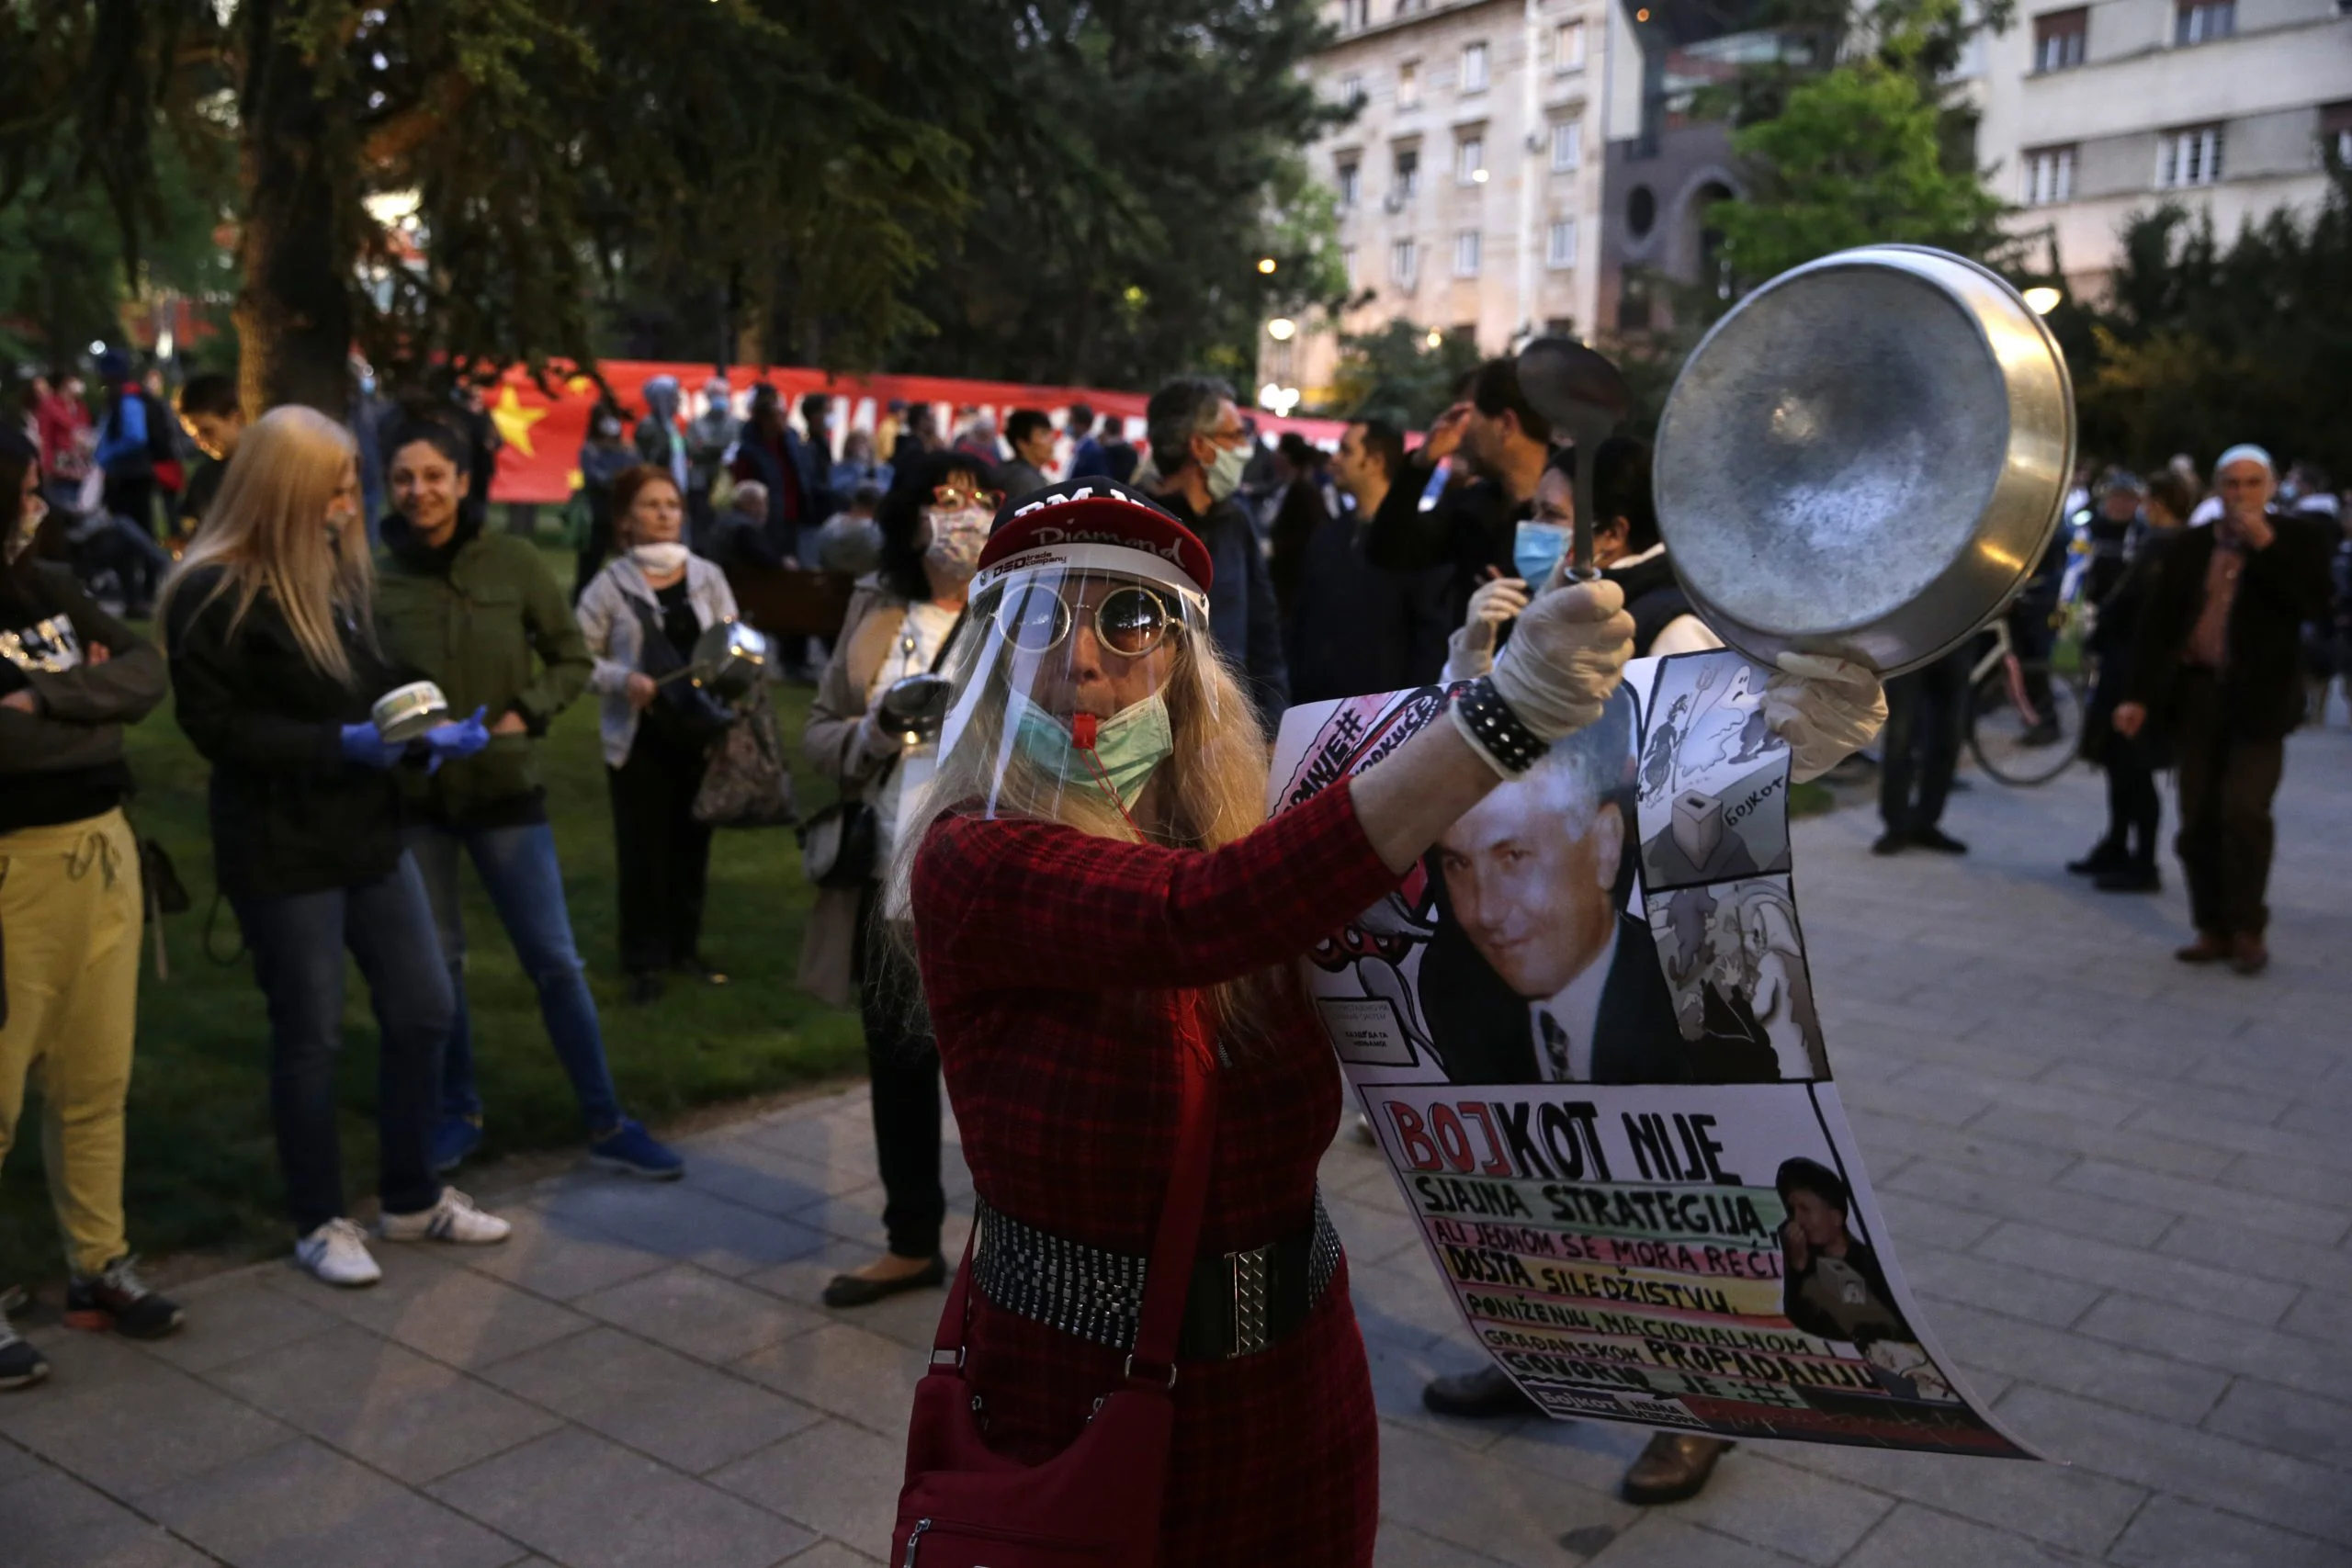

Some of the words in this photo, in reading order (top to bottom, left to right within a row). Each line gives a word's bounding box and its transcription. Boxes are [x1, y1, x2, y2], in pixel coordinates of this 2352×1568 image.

[1025, 557, 1067, 567] company
[1026, 551, 1052, 560] trade
[1030, 517, 1185, 568] Diamond
[1383, 1100, 1611, 1182] BOJKOT
[1621, 1111, 1743, 1187] NIJE
[1414, 1175, 1532, 1219] SJAJNA
[1433, 1220, 1468, 1244] ALI
[1475, 1222, 1556, 1255] JEDNOM
[1560, 1233, 1600, 1260] SE
[1610, 1238, 1700, 1272] MORA
[1446, 1245, 1535, 1288] DOSTA
[1599, 1311, 1813, 1356] NACIONALNOM
[1823, 1339, 1836, 1359] I
[1483, 1330, 1646, 1365] GRAĐANSKOM
[1644, 1338, 1887, 1389] PROPADANJU
[1678, 1372, 1724, 1396] JE
